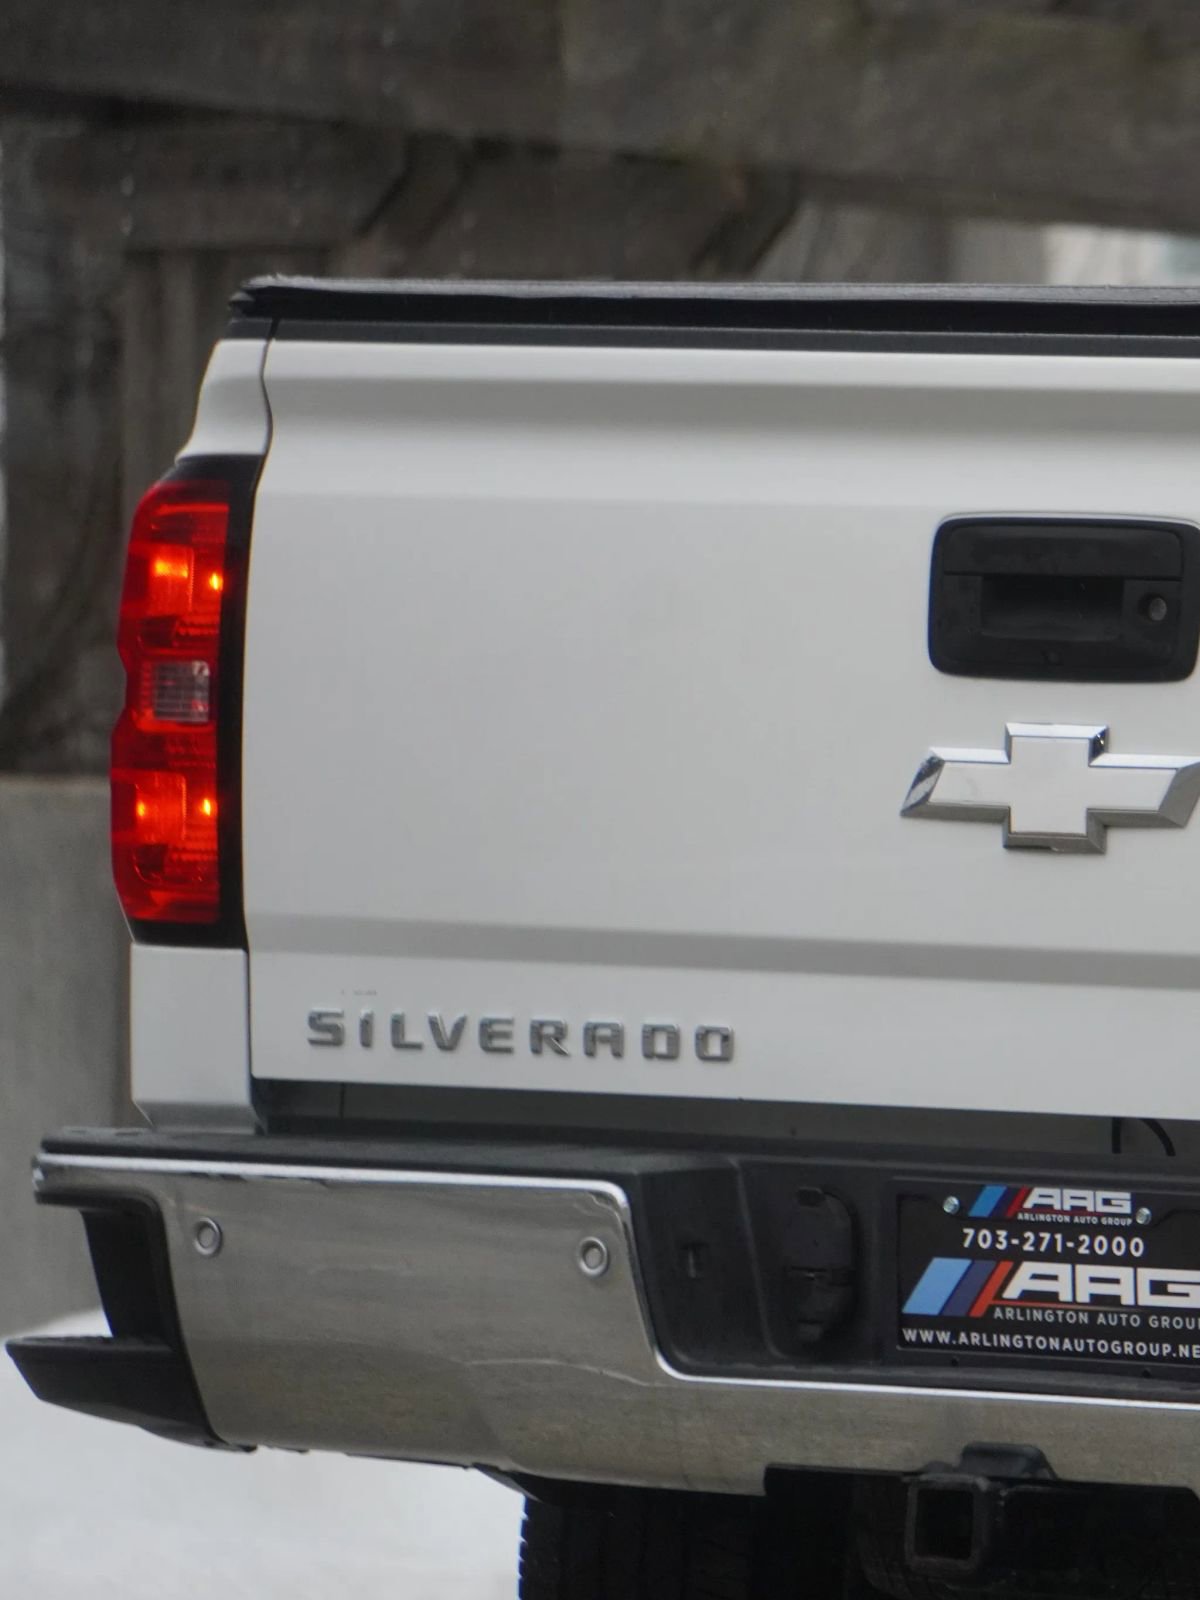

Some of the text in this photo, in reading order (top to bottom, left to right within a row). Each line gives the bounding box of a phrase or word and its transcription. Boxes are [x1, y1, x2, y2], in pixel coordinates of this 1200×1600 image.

[307, 1009, 735, 1062] SILVERADO
[1022, 1187, 1132, 1214] AAG
[1017, 1212, 1132, 1226] ARLINGTON AUTO GROUP
[962, 1228, 1145, 1257] 703-271-2000
[993, 1306, 1089, 1325] ARLINGTON
[1096, 1313, 1141, 1328] AUTO
